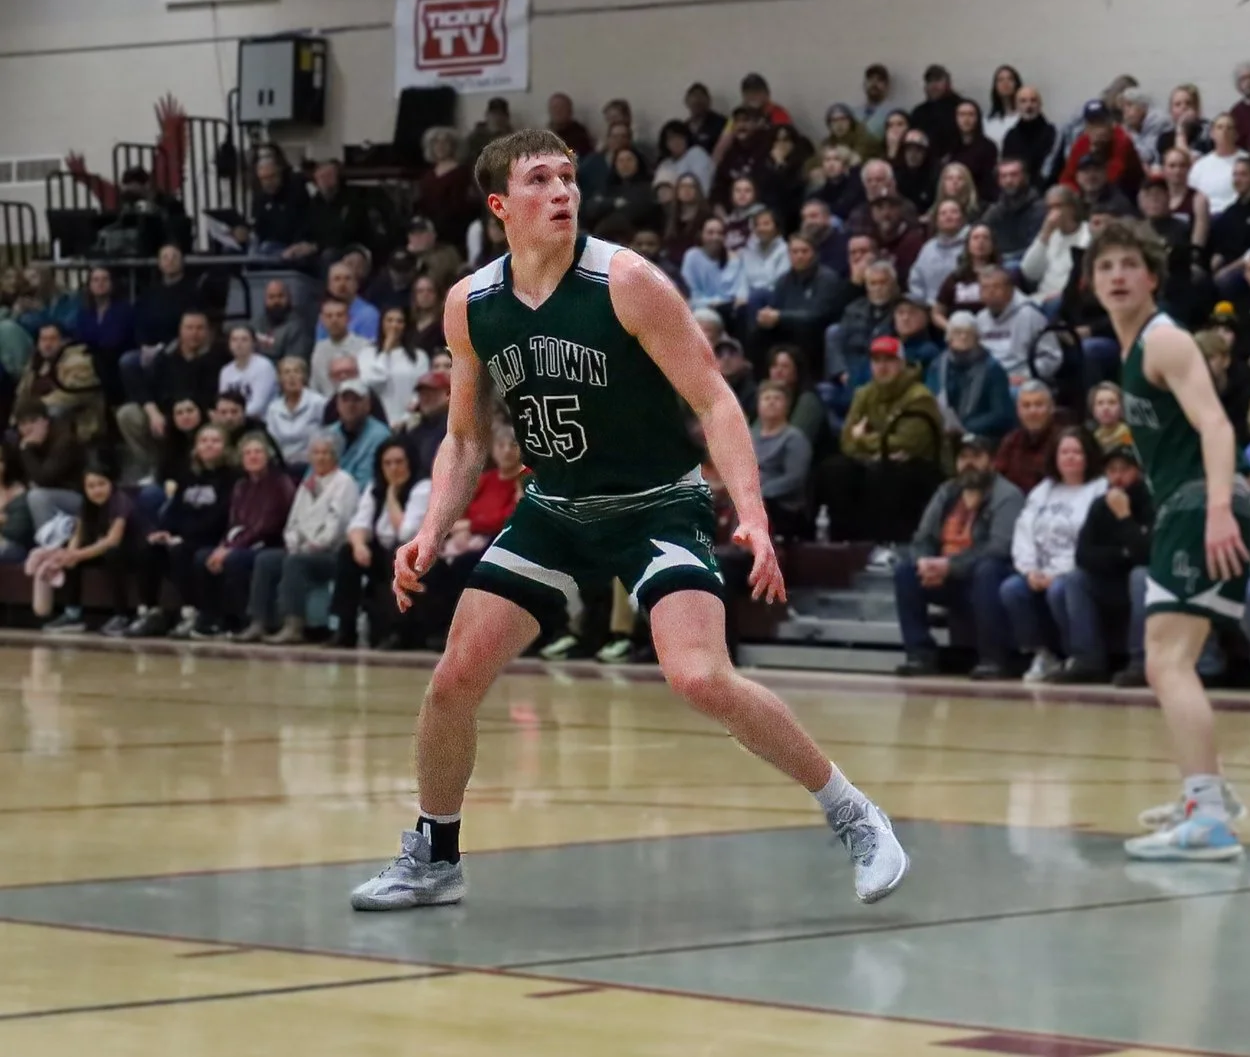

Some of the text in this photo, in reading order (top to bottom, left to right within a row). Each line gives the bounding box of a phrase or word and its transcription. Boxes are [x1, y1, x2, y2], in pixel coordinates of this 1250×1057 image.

[432, 25, 486, 56] TV
[529, 335, 607, 387] TOWN
[519, 395, 588, 463] 35
